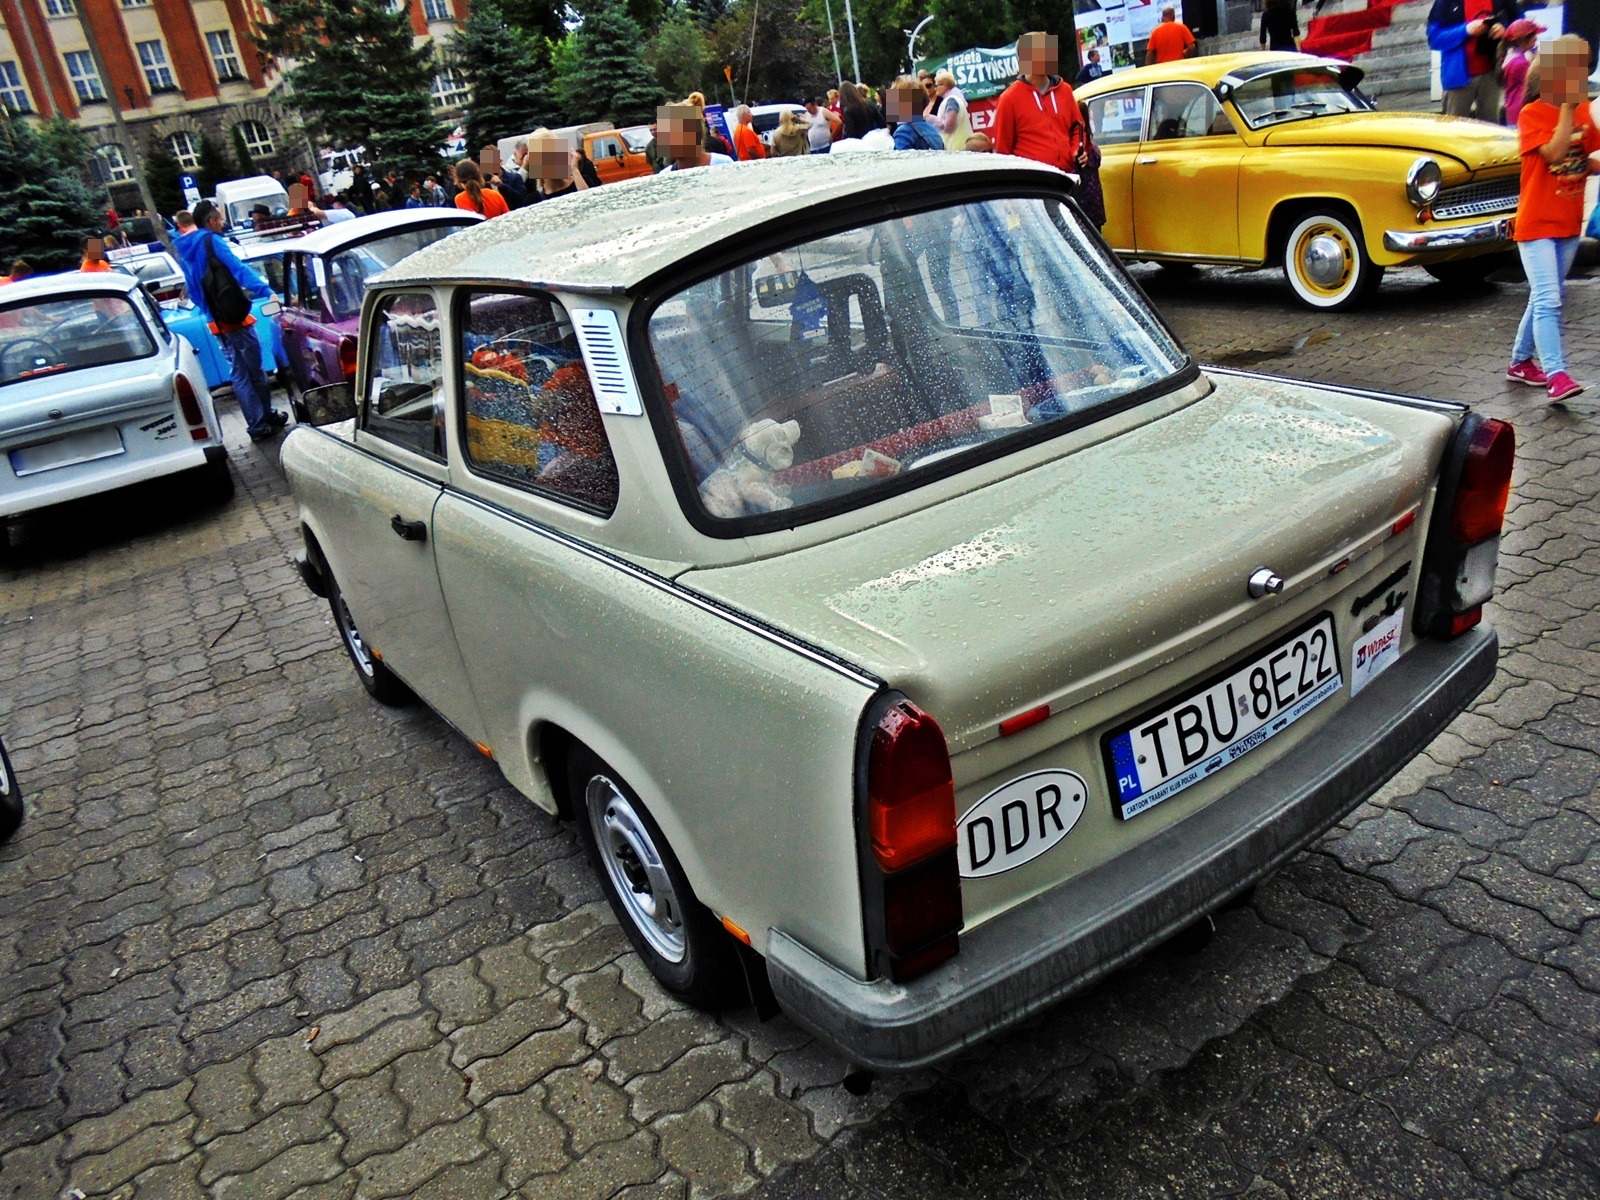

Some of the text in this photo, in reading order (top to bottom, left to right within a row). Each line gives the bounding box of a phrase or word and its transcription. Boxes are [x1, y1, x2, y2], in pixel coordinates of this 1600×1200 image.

[947, 51, 982, 67] gazeta
[183, 176, 193, 188] P
[1140, 628, 1332, 778] TBU 8E22
[1293, 680, 1339, 716] cartoontrabant.pl
[1118, 774, 1137, 794] PL
[1126, 772, 1198, 815] CARTOON TRABANT KLUB POLSKA
[967, 784, 1065, 871] DDR
